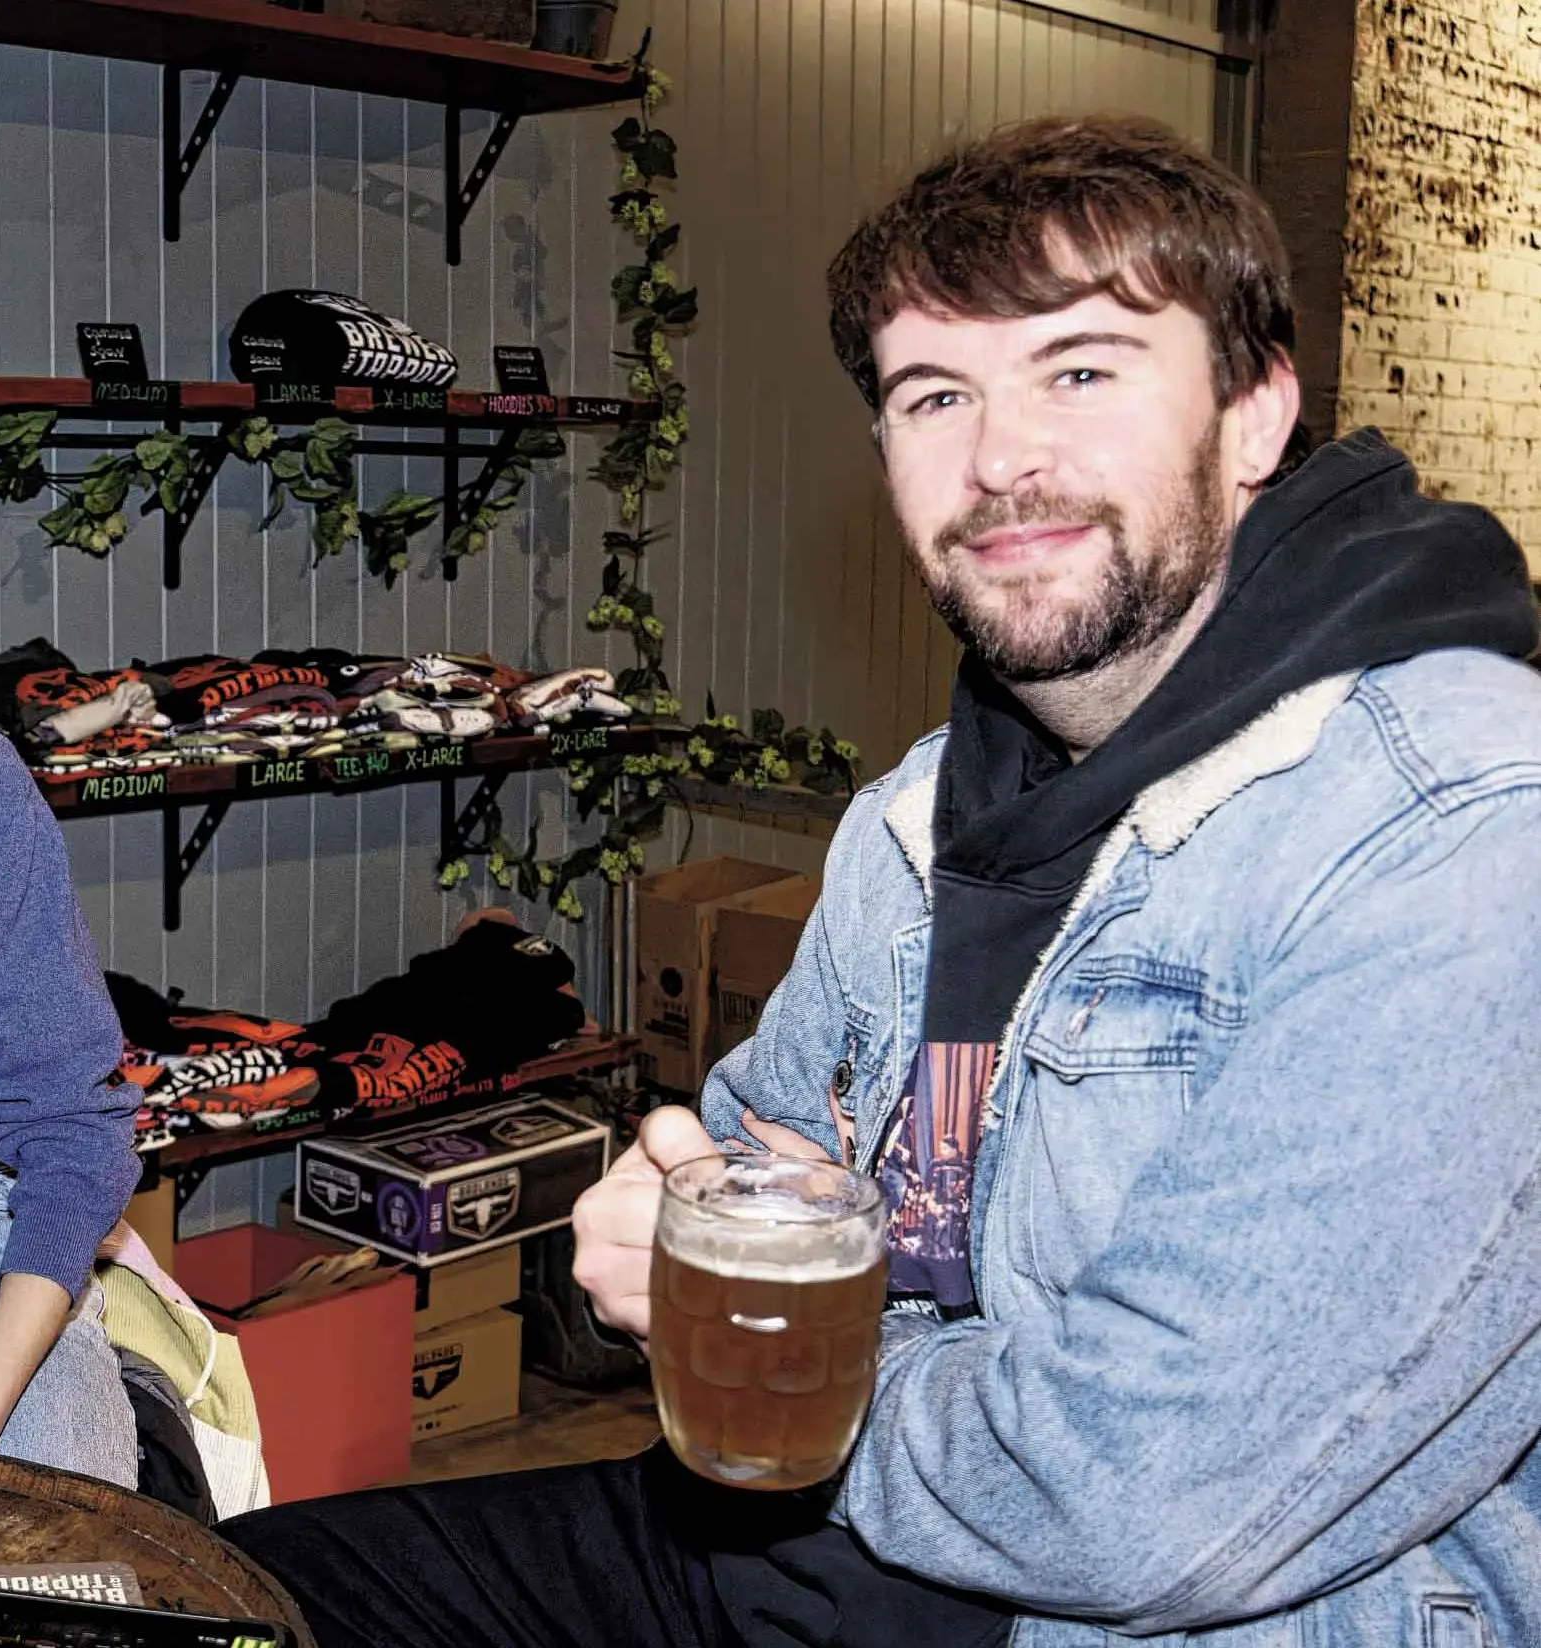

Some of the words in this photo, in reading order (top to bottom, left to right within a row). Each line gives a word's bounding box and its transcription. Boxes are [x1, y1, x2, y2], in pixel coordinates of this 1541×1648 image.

[337, 321, 455, 362] BREWER
[269, 382, 321, 403] LARGE
[551, 731, 608, 755] 2X-LARGE
[406, 746, 464, 770] X-LARGE
[251, 759, 306, 787] LARGE
[81, 773, 165, 801] MEDIUM
